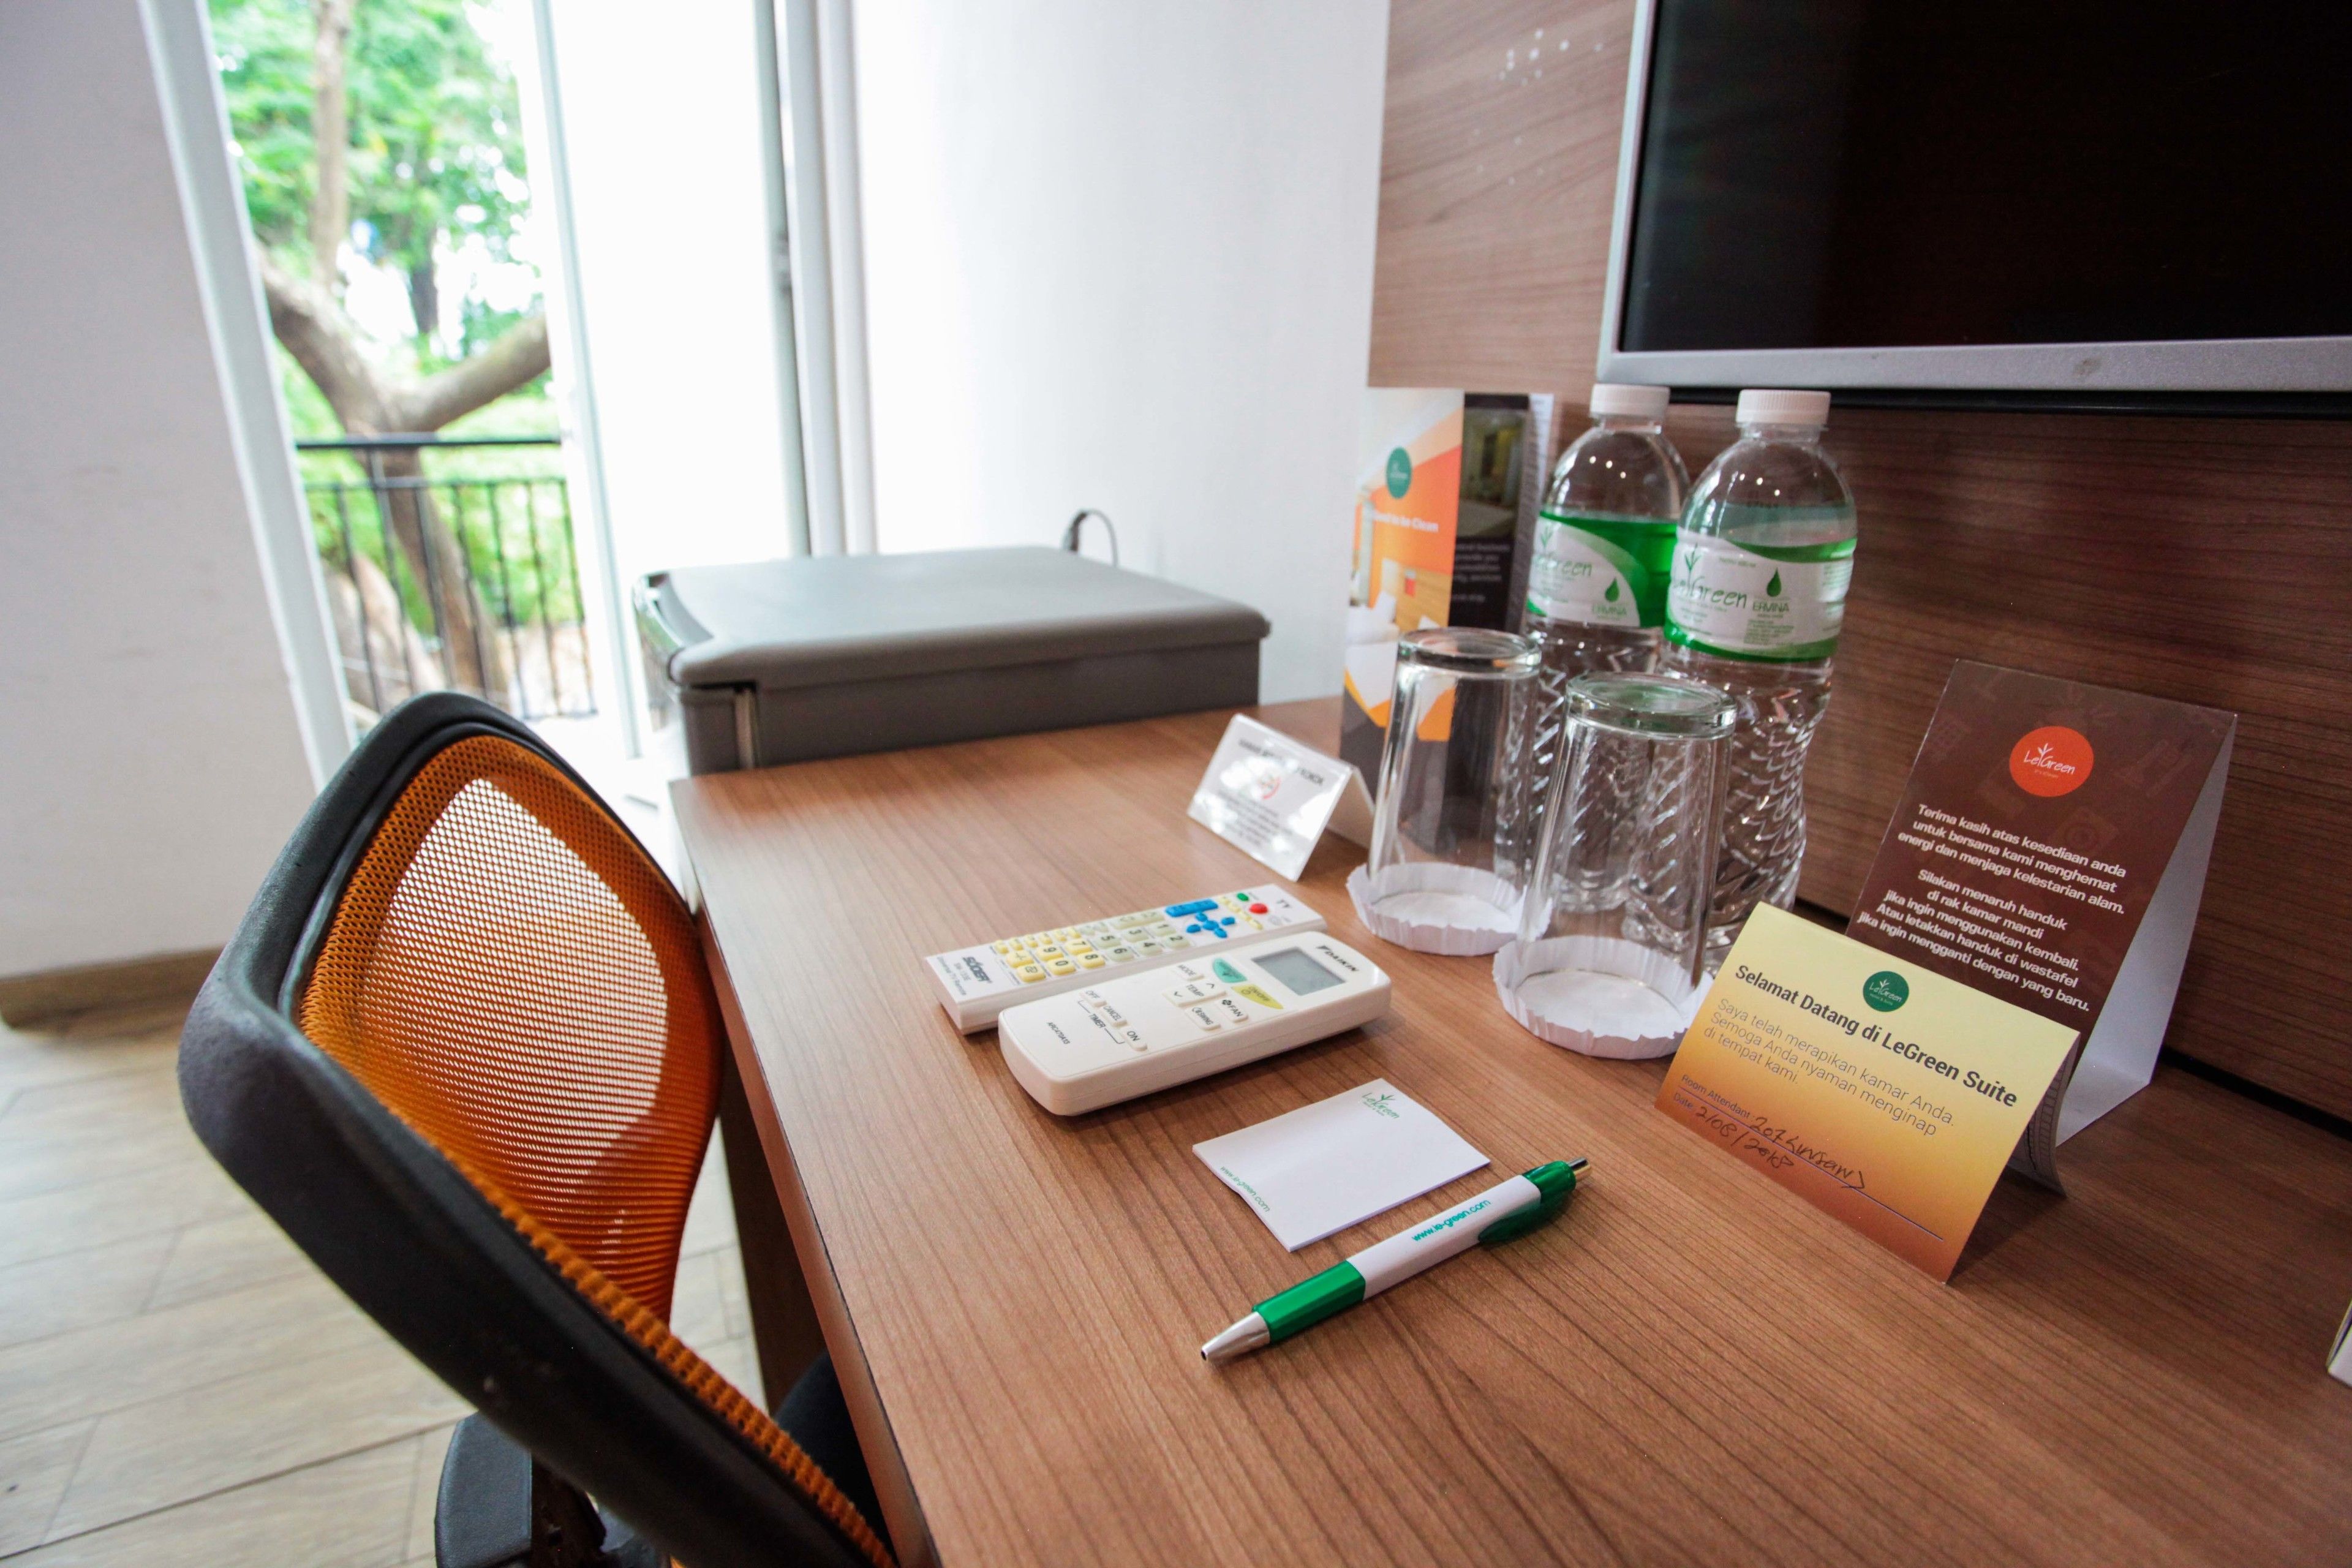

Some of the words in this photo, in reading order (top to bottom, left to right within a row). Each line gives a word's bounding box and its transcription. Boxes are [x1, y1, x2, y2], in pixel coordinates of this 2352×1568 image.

[2022, 748, 2076, 775] LeGreen
[1912, 821, 1947, 838] untuk
[1948, 830, 2000, 856] bersama
[2002, 847, 2035, 866] kami
[2035, 859, 2117, 893] menghemat
[1918, 804, 1958, 825] Terima
[1958, 816, 1991, 836] kasih
[1992, 829, 2020, 845] atas
[2021, 836, 2089, 867] kesediaan
[2090, 860, 2127, 878] anda
[1898, 832, 1936, 851] energi
[1935, 843, 1958, 858] dan
[1959, 852, 2012, 876] menjaga
[2013, 868, 2086, 901] kelestarian
[2087, 895, 2125, 914] alam.
[1918, 869, 1960, 892] Silakan
[1961, 886, 2016, 912] menaruh
[2018, 904, 2068, 930] handuk
[1927, 890, 1941, 902] di
[1940, 895, 1960, 910] rak
[1961, 902, 2002, 924] kamar
[2002, 918, 2045, 939] mandi
[1875, 903, 1904, 921] Atau
[1905, 913, 1956, 941] letakkan
[1956, 933, 2003, 960] handuk
[2004, 953, 2019, 965] di
[2019, 959, 2079, 988] wastafel
[1906, 897, 1936, 917] ingin
[1936, 911, 2023, 949] menggunakan
[2024, 941, 2079, 971] kembali.
[1177, 963, 1197, 976] MODE
[1879, 919, 1908, 939] ingin
[1908, 932, 1972, 964] mengganti
[1972, 958, 2020, 983] dengan
[2020, 977, 2054, 999] yang
[2055, 989, 2090, 1012] baru.
[1085, 990, 1101, 999] OFF
[1185, 984, 1205, 997] TEMP
[1869, 981, 1902, 1003] LeGreen
[1088, 1013, 1107, 1029] TIMER
[1102, 1005, 1122, 1021] CANCEL
[1197, 1009, 1214, 1025] SWING
[1227, 1005, 1243, 1017] FAN
[1126, 1030, 1142, 1042] ON
[1735, 965, 1800, 1005] Selamat
[1800, 995, 1860, 1036] Datang
[1861, 1024, 1883, 1042] di
[1882, 1032, 1960, 1080] LeGreen
[1962, 1071, 2018, 1107] Suite
[1703, 1027, 1716, 1040] di
[1717, 1033, 1763, 1065] tempat
[1764, 1057, 1799, 1084] kami.
[1711, 1012, 1763, 1046] Semoga
[1763, 1040, 1798, 1065] Anda
[1800, 1059, 1858, 1095] nyaman
[1860, 1090, 1937, 1136] menginap
[1718, 998, 1749, 1022] Saya
[1751, 1016, 1783, 1039] telah
[1785, 1033, 1858, 1076] merapikan
[1860, 1068, 1910, 1101] kamar
[1910, 1096, 1954, 1127] Anda.
[1681, 1074, 1707, 1094] Room
[1362, 1092, 1400, 1119] LeGreen
